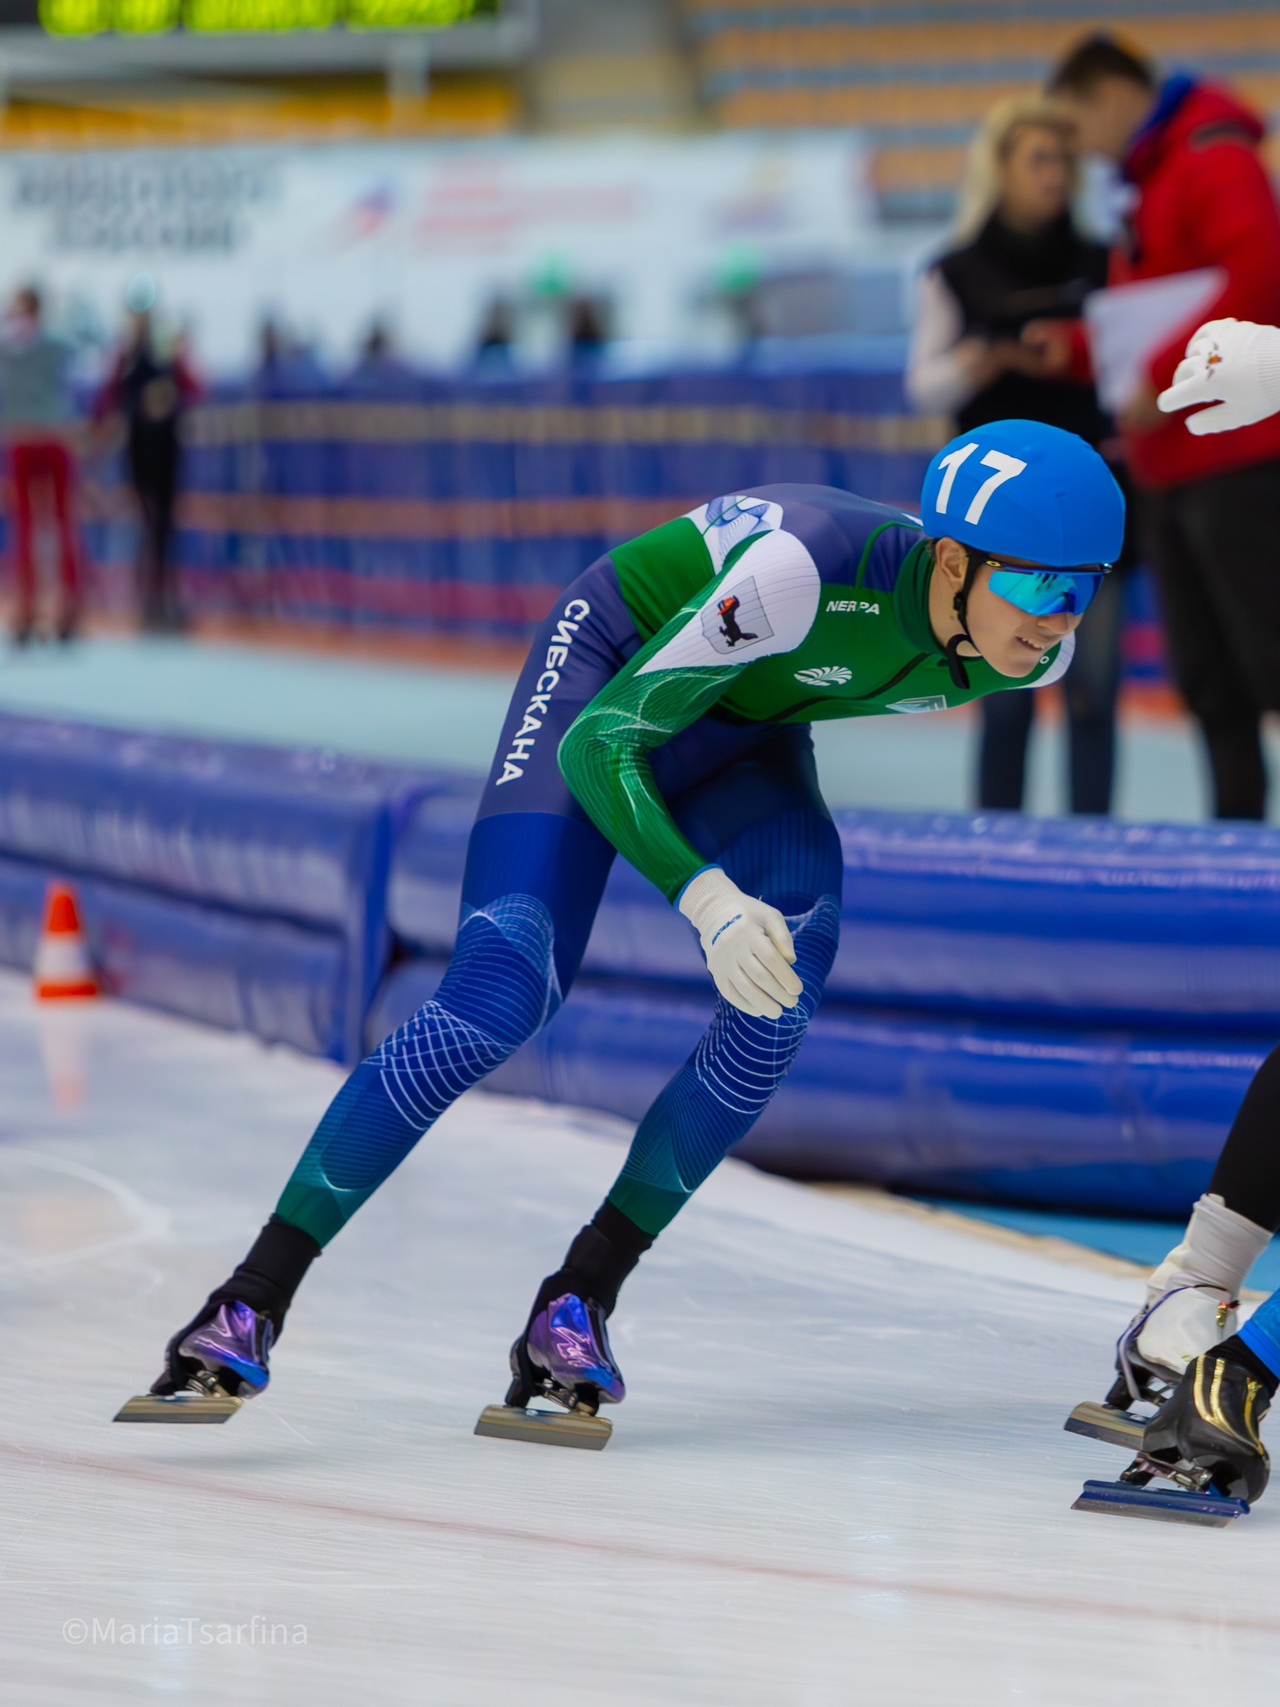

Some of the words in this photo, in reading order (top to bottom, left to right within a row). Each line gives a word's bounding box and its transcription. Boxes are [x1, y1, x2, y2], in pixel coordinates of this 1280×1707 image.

[936, 443, 1027, 525] 17
[826, 600, 880, 615] NERPA
[495, 599, 590, 786] СИБСКАНА
